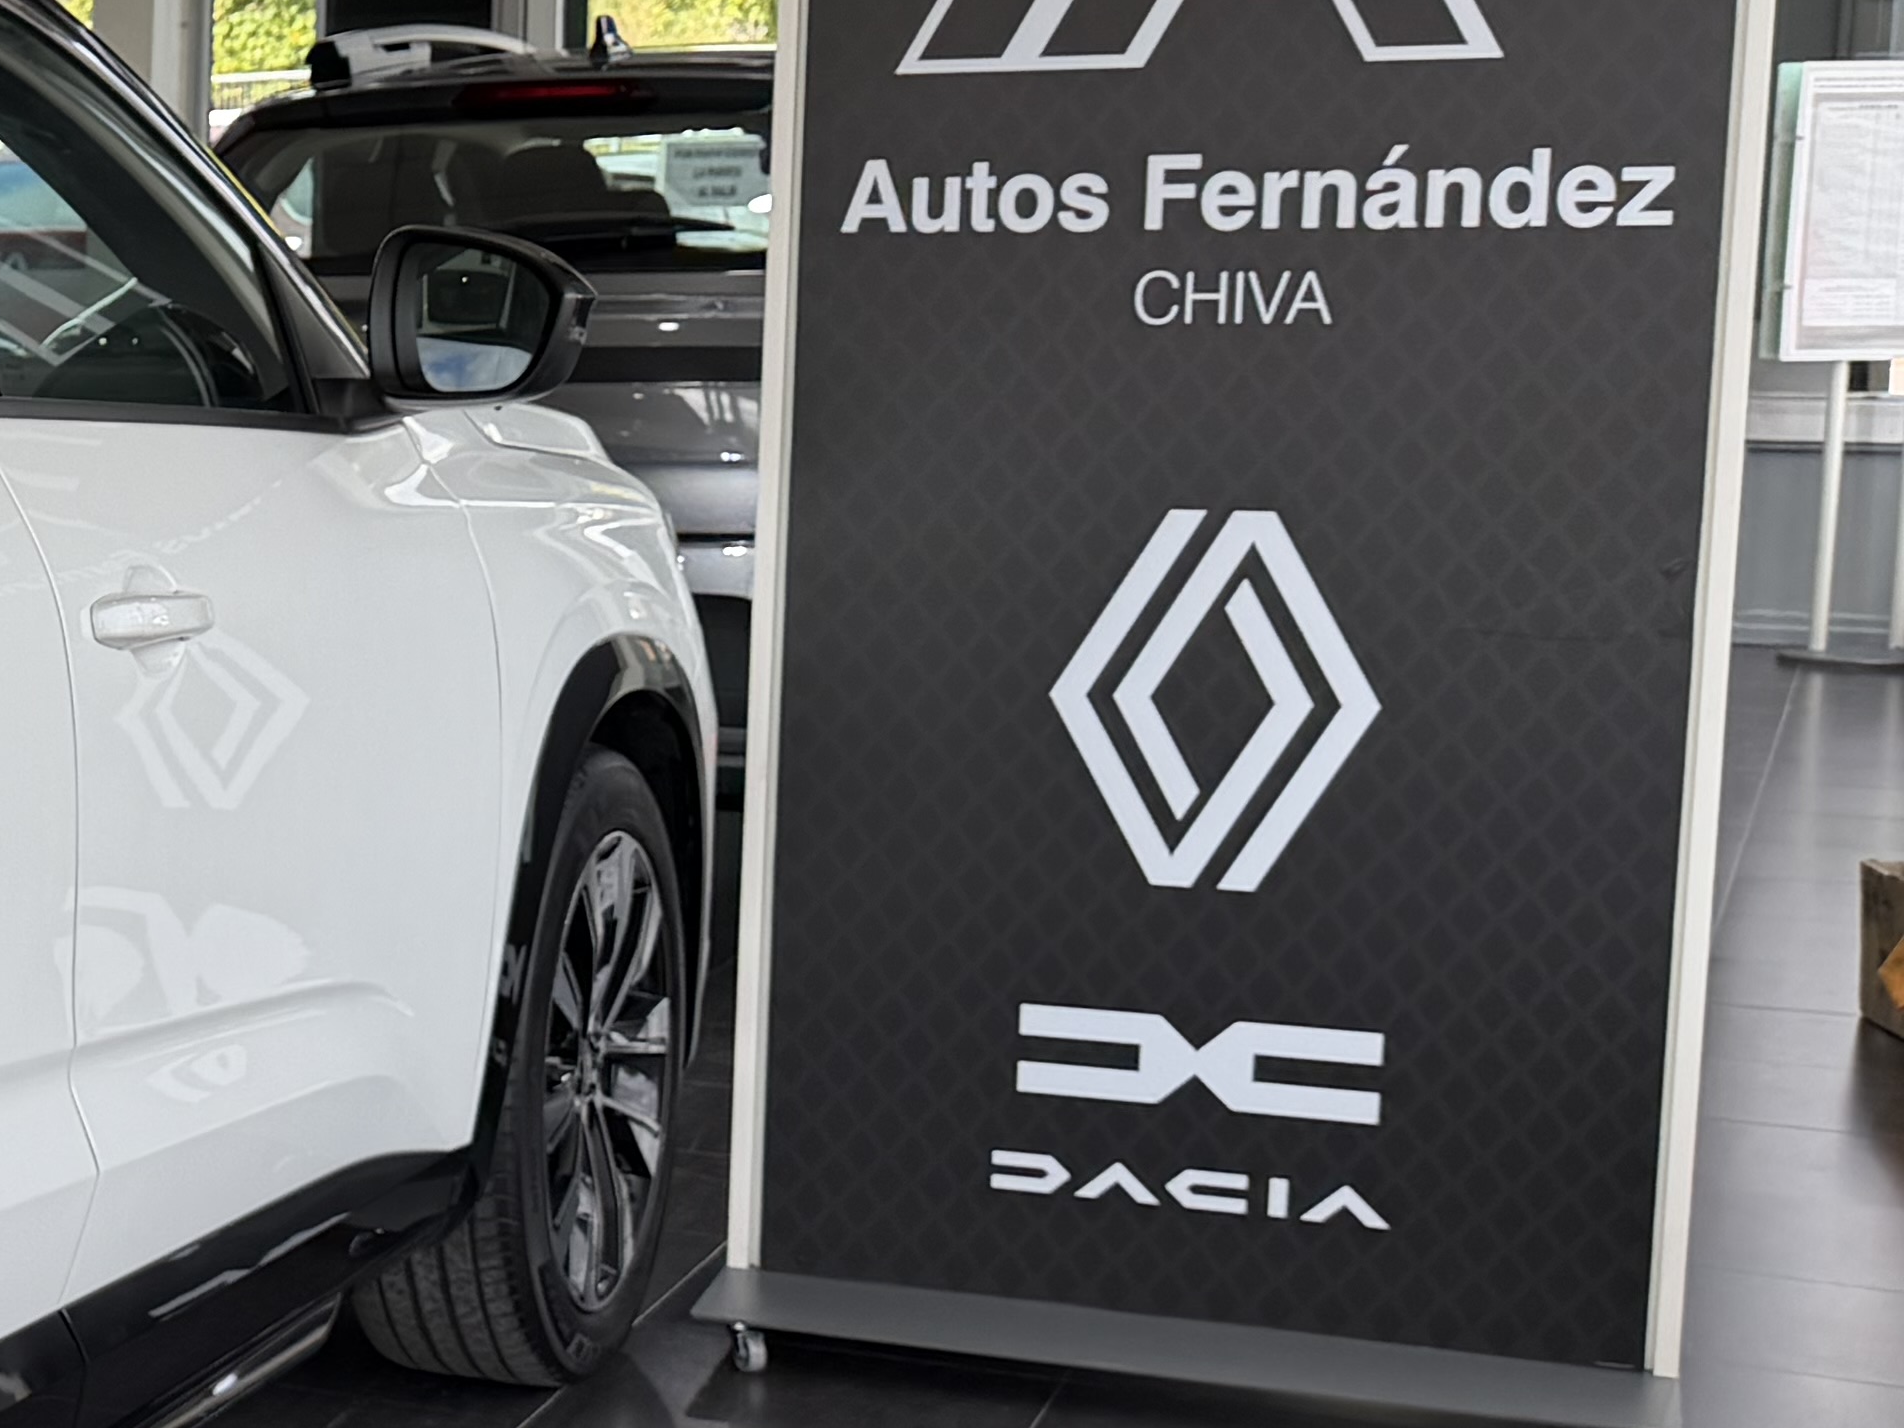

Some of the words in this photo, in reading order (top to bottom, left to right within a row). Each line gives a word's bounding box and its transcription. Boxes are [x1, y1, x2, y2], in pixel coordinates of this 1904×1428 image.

[840, 158, 1110, 234] Autos
[1143, 144, 1676, 231] Fernández
[1133, 269, 1333, 326] CHIVA
[990, 1149, 1391, 1230] DACIA
